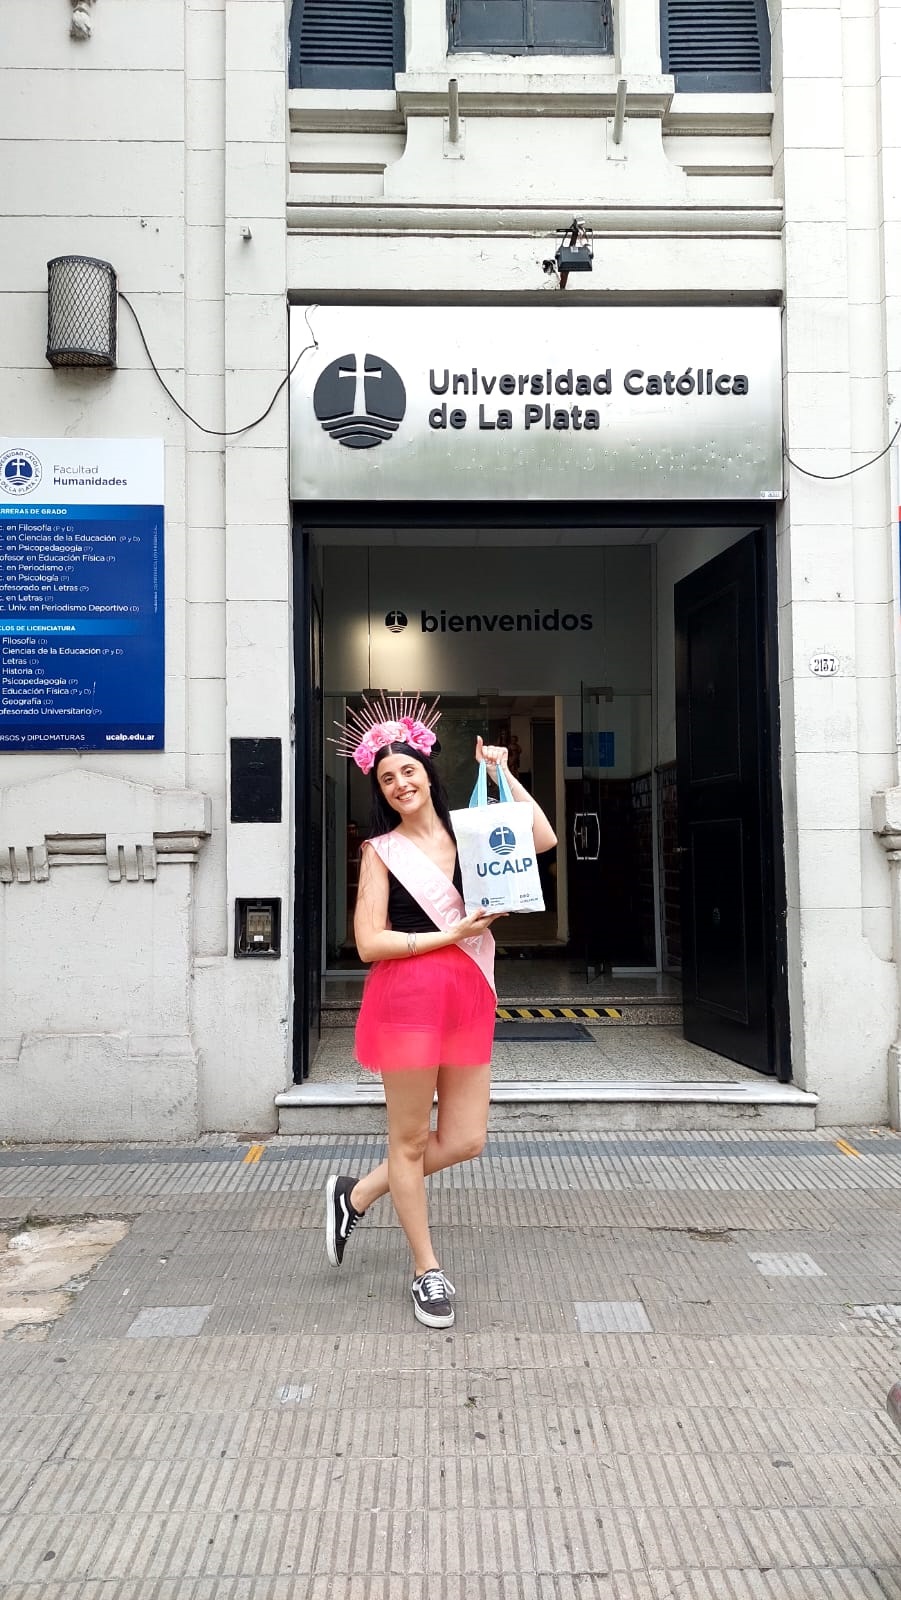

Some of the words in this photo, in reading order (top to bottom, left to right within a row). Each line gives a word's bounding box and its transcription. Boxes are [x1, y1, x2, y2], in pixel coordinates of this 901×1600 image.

[429, 368, 612, 396] Universidad
[623, 368, 749, 396] Católica
[429, 403, 467, 429] de
[479, 404, 513, 430] La
[524, 404, 601, 430] Plata
[53, 464, 99, 474] Facultad
[53, 477, 127, 486] Humanidades
[18, 534, 51, 542] Ciencias
[53, 534, 64, 542] de
[66, 534, 73, 542] la
[74, 534, 117, 542] Educación
[39, 553, 80, 561] Educación
[0, 584, 39, 592] ofesorado
[53, 584, 78, 592] Letras
[18, 594, 43, 602] Letras
[8, 604, 27, 612] Univ.
[42, 604, 86, 612] Periodismo
[88, 604, 128, 613] Deportivo
[420, 608, 593, 633] bienvenidos
[2, 647, 35, 655] Ciencias
[38, 647, 48, 655] de
[50, 647, 57, 655] la
[59, 647, 100, 655] Educación
[2, 687, 44, 695] Educación
[46, 687, 69, 695] Física
[0, 707, 39, 715] ofesorado
[41, 707, 92, 715] Universitario
[106, 733, 155, 741] ucalp.edu.ar
[476, 857, 533, 877] UCALP
